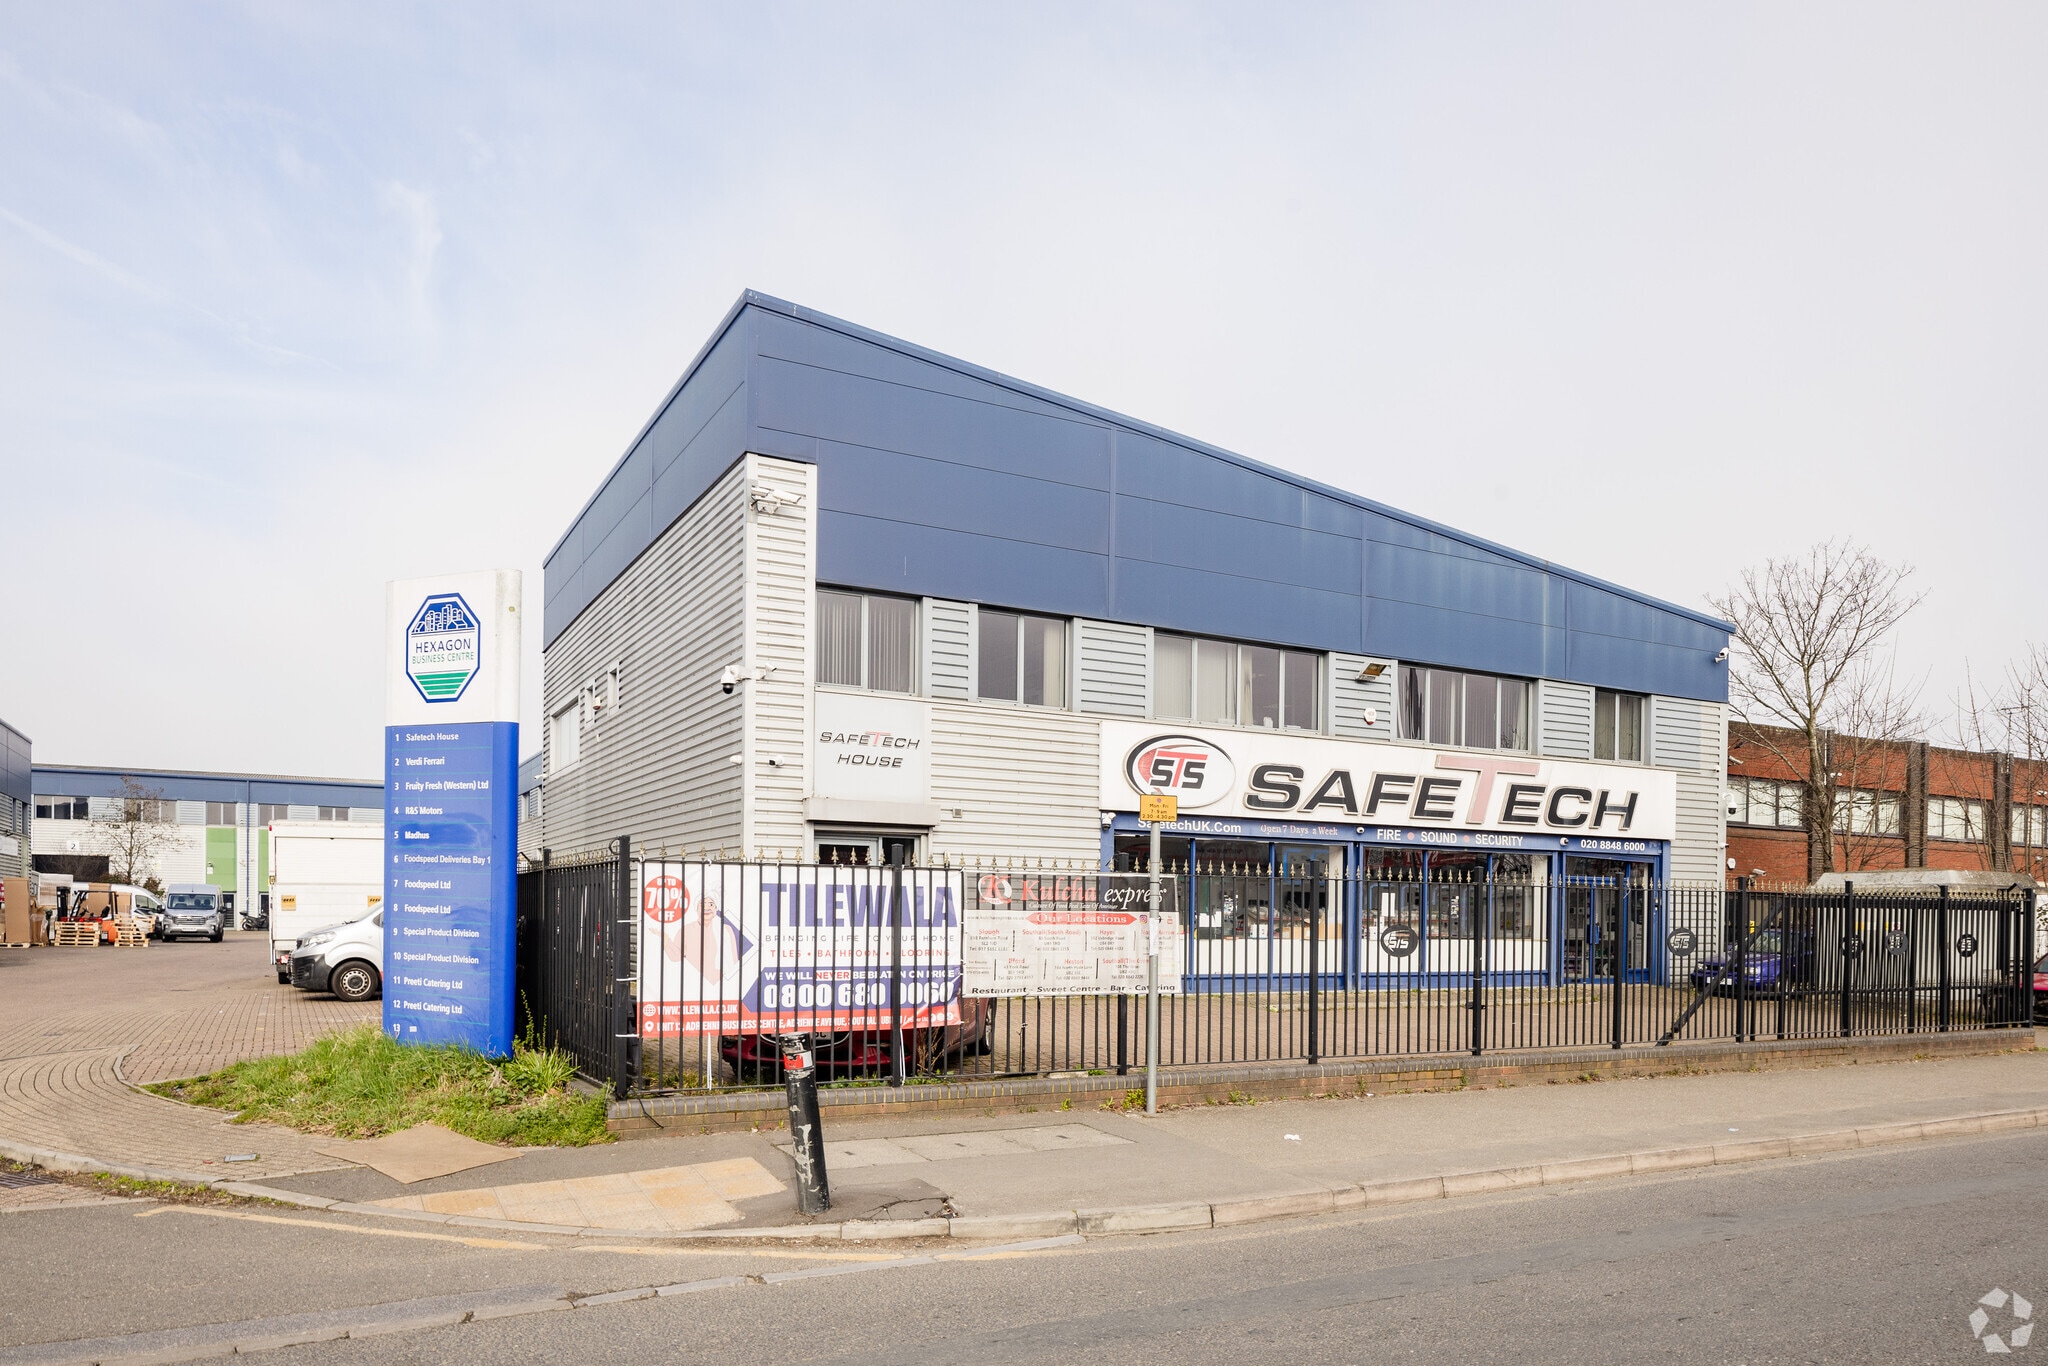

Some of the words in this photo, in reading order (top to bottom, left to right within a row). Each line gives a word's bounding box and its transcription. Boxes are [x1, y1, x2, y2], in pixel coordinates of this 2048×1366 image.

[415, 638, 472, 654] HEXAGON
[412, 653, 445, 665] BUSINESS
[446, 651, 475, 662] CENTRE
[395, 733, 400, 741] 1
[405, 732, 435, 742] Safetech
[436, 732, 459, 741] House
[819, 730, 921, 749] SAFETECH
[394, 757, 400, 766] 2
[405, 757, 422, 766] Verdi
[423, 756, 445, 766] Ferrari
[837, 753, 904, 768] HOUSE
[1150, 750, 1208, 790] STS
[394, 782, 399, 791] 3
[405, 781, 424, 793] Fruity
[425, 780, 443, 790] Fresh
[443, 780, 476, 791] (Western)
[477, 780, 489, 789] Ltd
[1243, 754, 1640, 831] SAFETECH
[394, 806, 399, 815] 4
[405, 806, 418, 815] R&S
[419, 806, 443, 815] Motors
[1138, 818, 1242, 833] SaetechUK.Com
[1260, 824, 1281, 835] Open
[1282, 825, 1287, 833] 7
[1290, 825, 1309, 836] Days
[1318, 826, 1338, 836] Week
[394, 830, 399, 839] 5
[1376, 828, 1402, 841] FIRE
[1420, 831, 1458, 844] SOUND
[1475, 833, 1524, 846] SECURITY
[1580, 838, 1598, 849] 020
[1600, 840, 1621, 850] 8848
[1624, 841, 1646, 851] 6000
[393, 855, 398, 863] 6
[404, 854, 439, 864] Foodspeed
[439, 855, 471, 864] Deliveries
[472, 855, 486, 866] Bay
[486, 856, 491, 864] 1
[393, 879, 398, 887] 7
[404, 879, 439, 890] Foodspeed
[440, 880, 451, 889] Ltd
[1022, 877, 1097, 902] Kulcha
[645, 887, 689, 909] 70%
[393, 903, 398, 912] 8
[404, 903, 439, 914] Foodspeed
[440, 905, 451, 914] Ltd
[760, 883, 958, 928] TILEWALA
[1036, 913, 1062, 923] Our
[1067, 913, 1127, 923] Locations
[393, 927, 398, 936] 9
[403, 927, 427, 937] Special
[427, 928, 452, 937] Product
[453, 928, 480, 938] Division
[978, 928, 1000, 936] Slough
[393, 951, 401, 960] 10
[403, 951, 426, 962] Special
[426, 953, 452, 962] Product
[452, 954, 479, 964] Division
[770, 949, 802, 957] TLES
[897, 949, 951, 957] LOORING
[765, 971, 784, 980] WE
[816, 971, 850, 980] NEVER
[393, 975, 400, 984] 11
[403, 976, 422, 986] Preeti
[423, 978, 450, 990] Catering
[451, 980, 463, 989] Ltd
[763, 983, 832, 1008] 0800
[838, 983, 886, 1007] 680
[393, 999, 401, 1008] 12
[403, 1000, 422, 1010] Preeti
[423, 1002, 450, 1014] Catering
[451, 1005, 463, 1014] Ltd
[393, 1023, 401, 1032] 13
